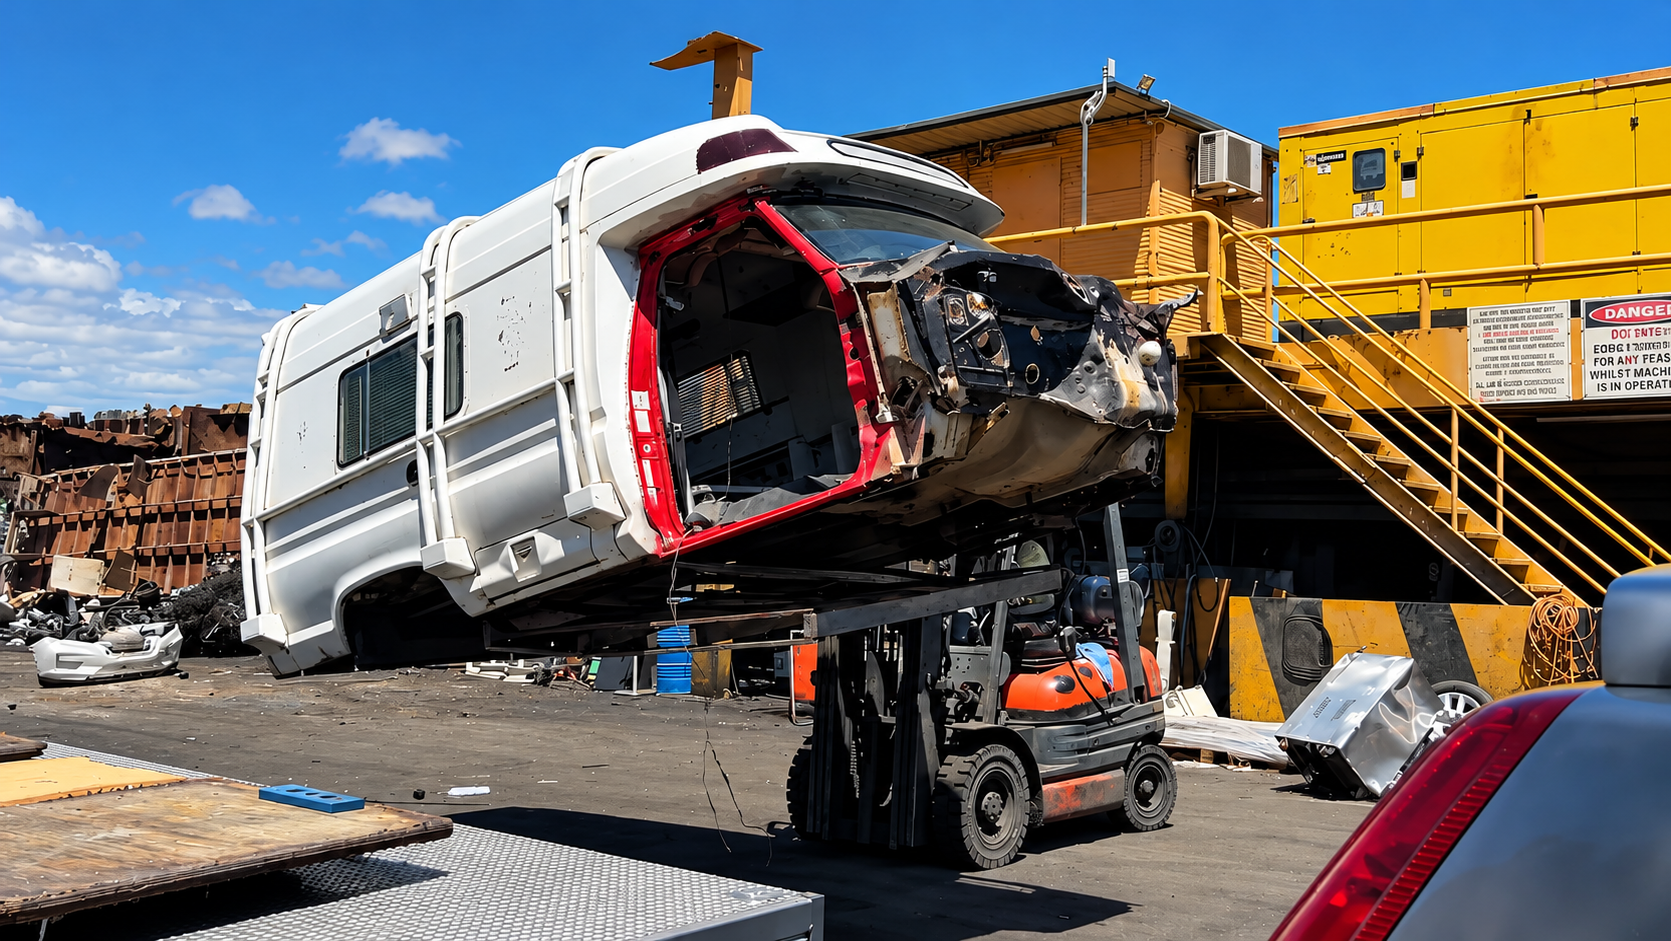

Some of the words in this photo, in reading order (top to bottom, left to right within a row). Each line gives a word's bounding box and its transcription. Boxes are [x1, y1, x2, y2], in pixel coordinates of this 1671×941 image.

[1594, 357, 1614, 366] FOR
[1617, 355, 1639, 365] ANY
[1590, 369, 1631, 379] WHILST
[1597, 383, 1607, 392] IS
[1610, 382, 1621, 391] IN
